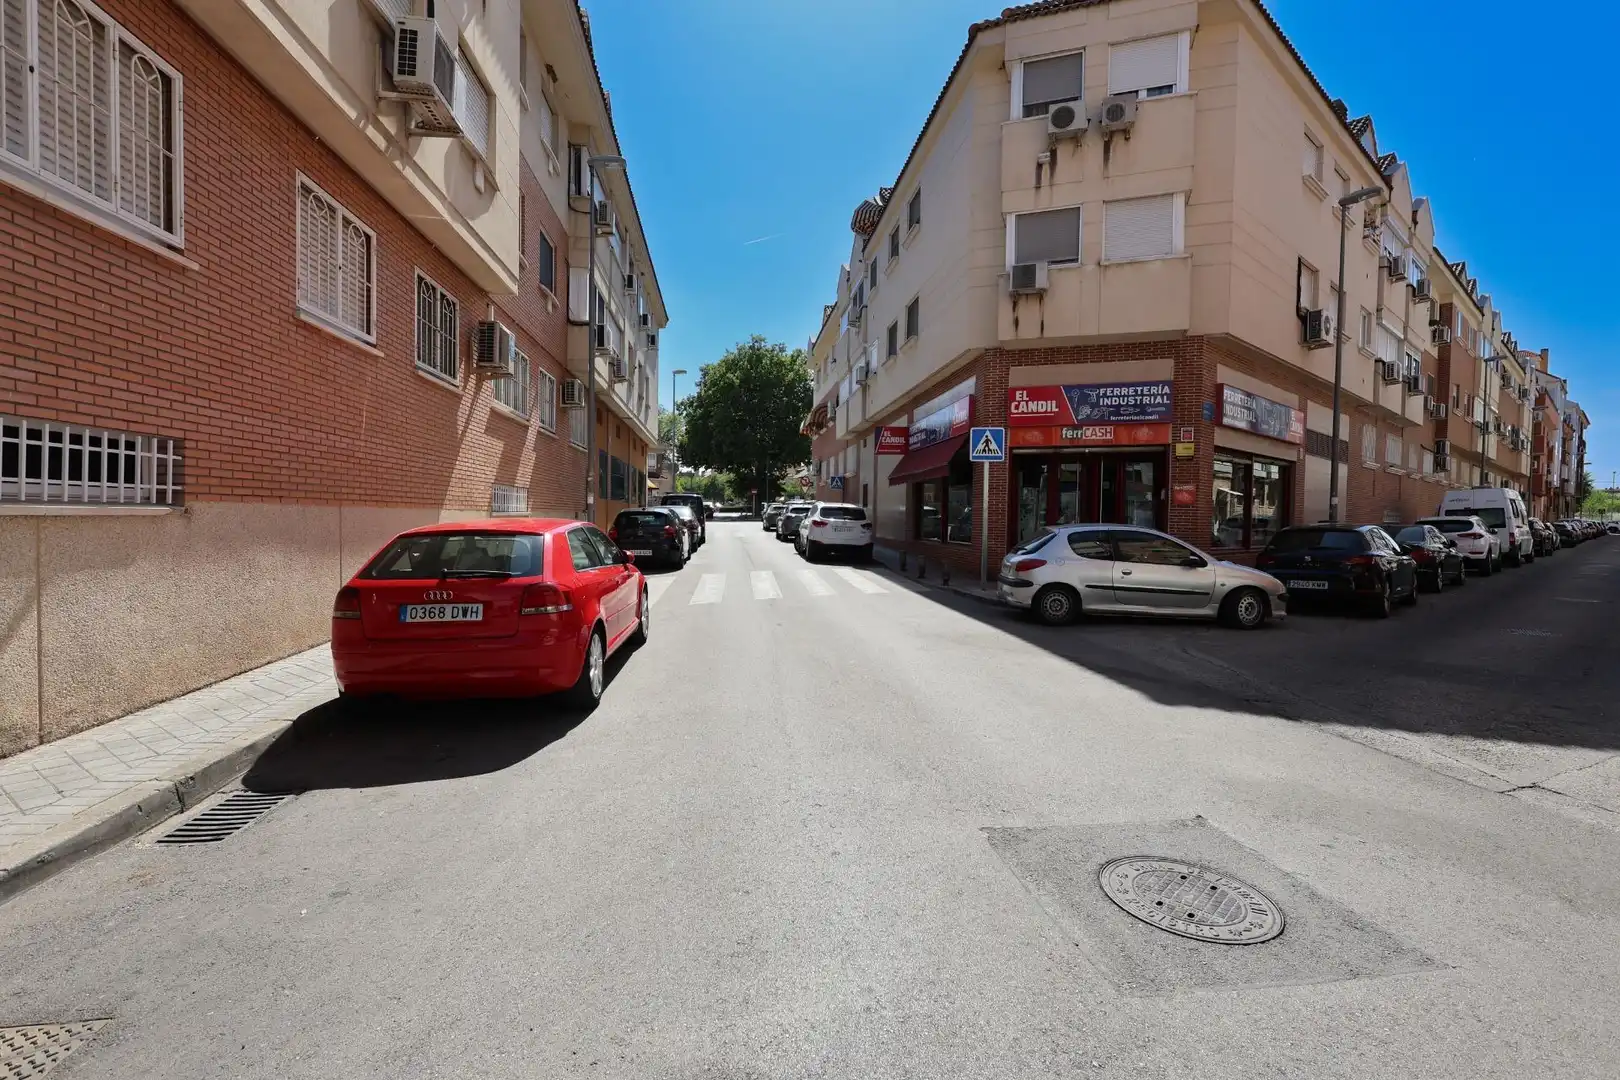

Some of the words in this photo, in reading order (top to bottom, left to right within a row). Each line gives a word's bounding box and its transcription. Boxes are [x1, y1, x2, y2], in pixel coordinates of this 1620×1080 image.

[1015, 390, 1029, 401] EL
[1099, 384, 1171, 396] FERRETERÍA
[1099, 395, 1171, 406] INDUSTRIAL
[1223, 389, 1257, 409] FERRETERÍA
[1010, 400, 1059, 413] CANDIL
[1223, 403, 1257, 422] INDUSTRIAL
[409, 606, 446, 619] 0368
[451, 606, 479, 619] DWH
